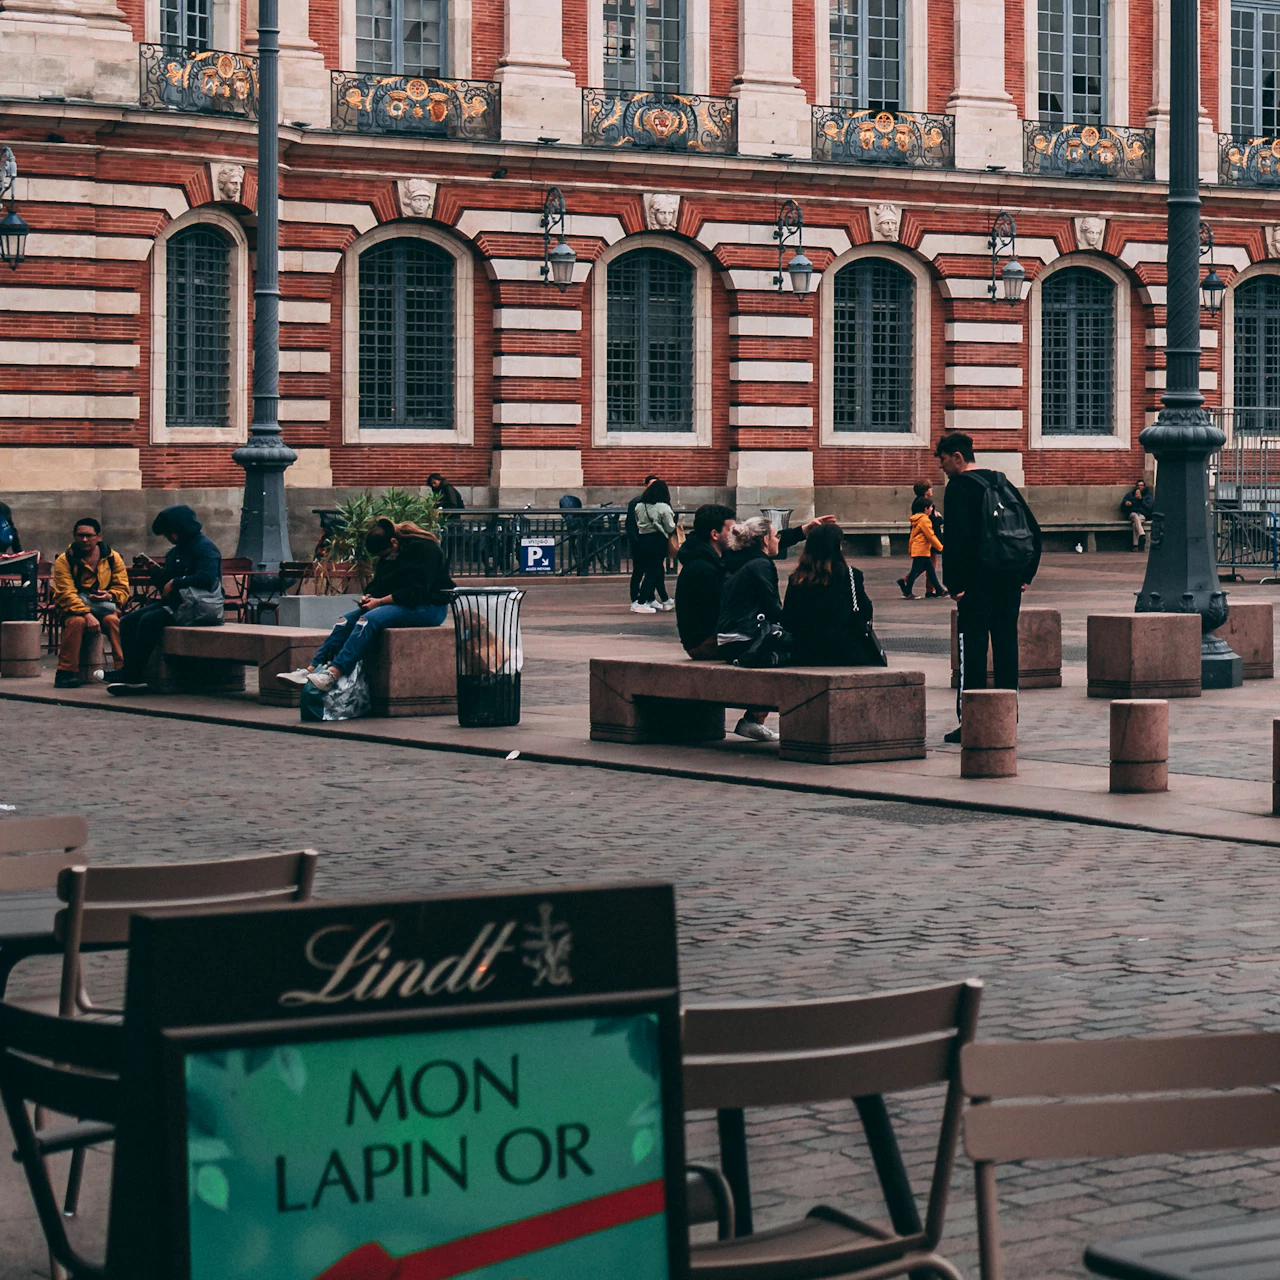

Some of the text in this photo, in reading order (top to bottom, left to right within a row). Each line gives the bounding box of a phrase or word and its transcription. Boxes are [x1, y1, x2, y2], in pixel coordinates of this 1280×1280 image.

[527, 546, 543, 566] P
[279, 919, 515, 1007] Lindt
[346, 1053, 520, 1126] MON
[275, 1122, 594, 1214] LAPIN OR
